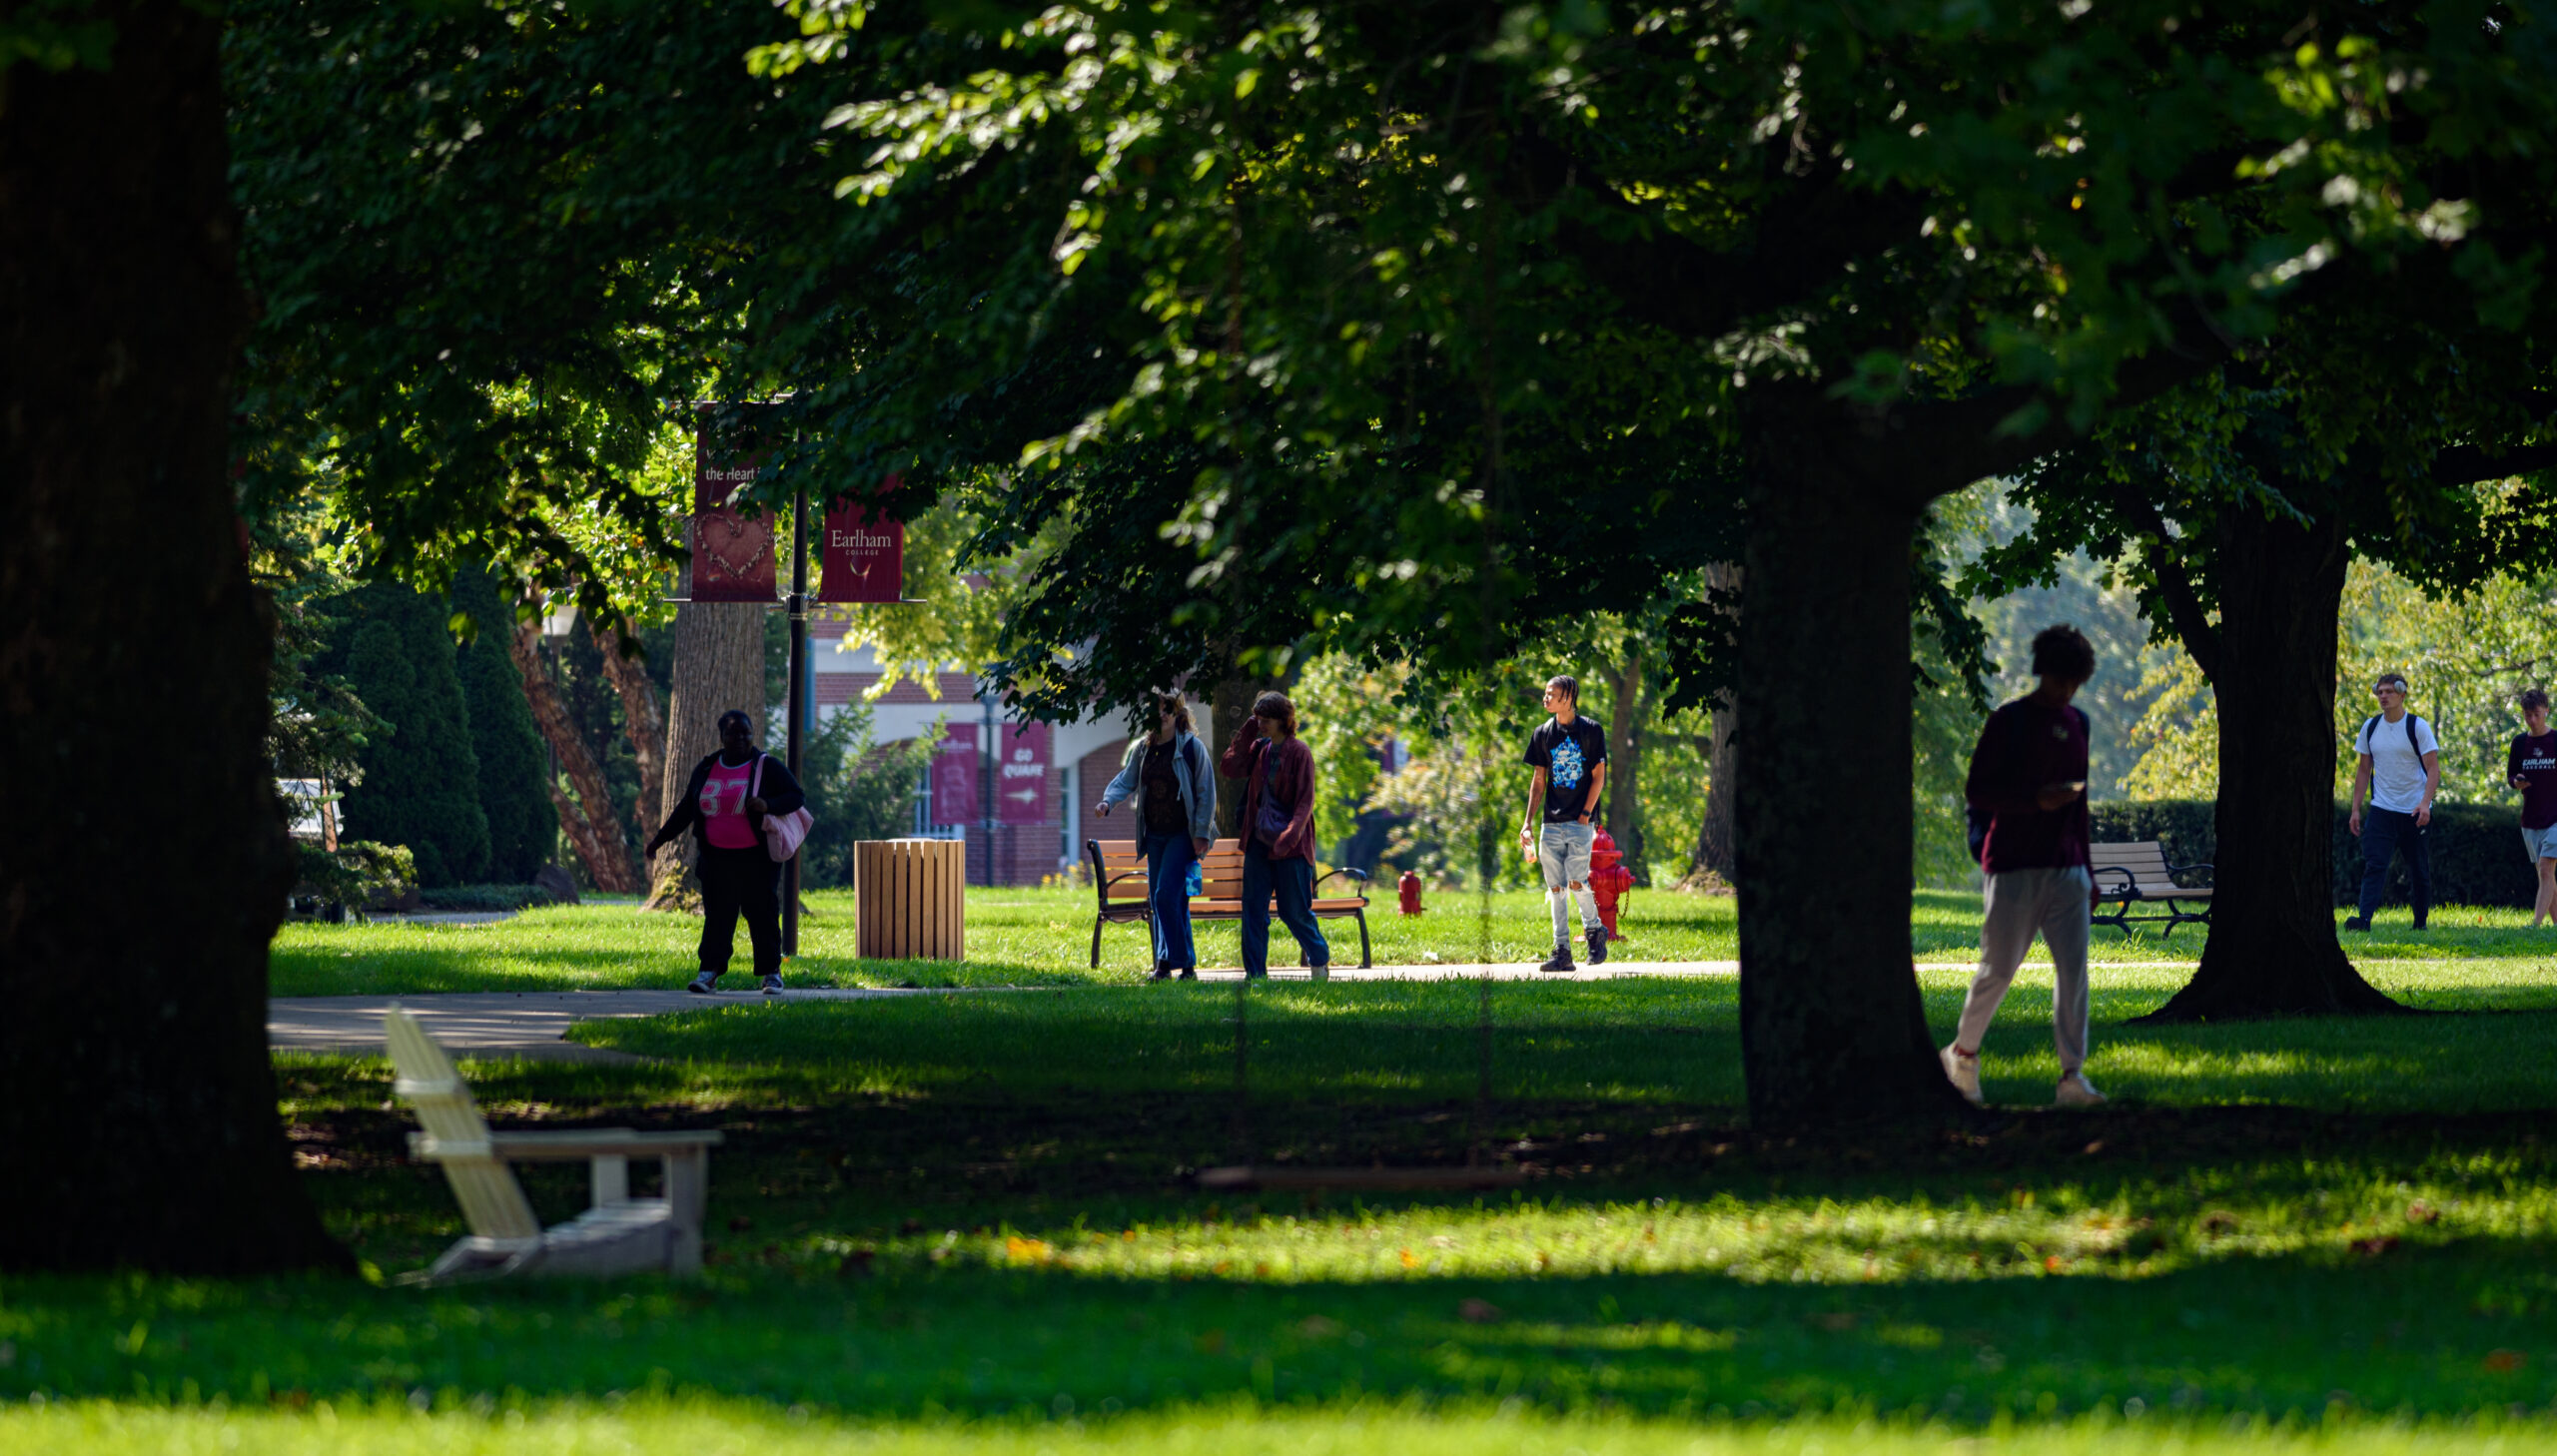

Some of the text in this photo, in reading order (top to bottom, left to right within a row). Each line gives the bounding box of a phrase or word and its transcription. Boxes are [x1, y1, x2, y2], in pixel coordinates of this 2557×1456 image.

[705, 466, 724, 481] the
[726, 466, 755, 481] Heart
[831, 528, 892, 548] Earlham
[1014, 748, 1034, 762] GO
[700, 779, 749, 816] 87
